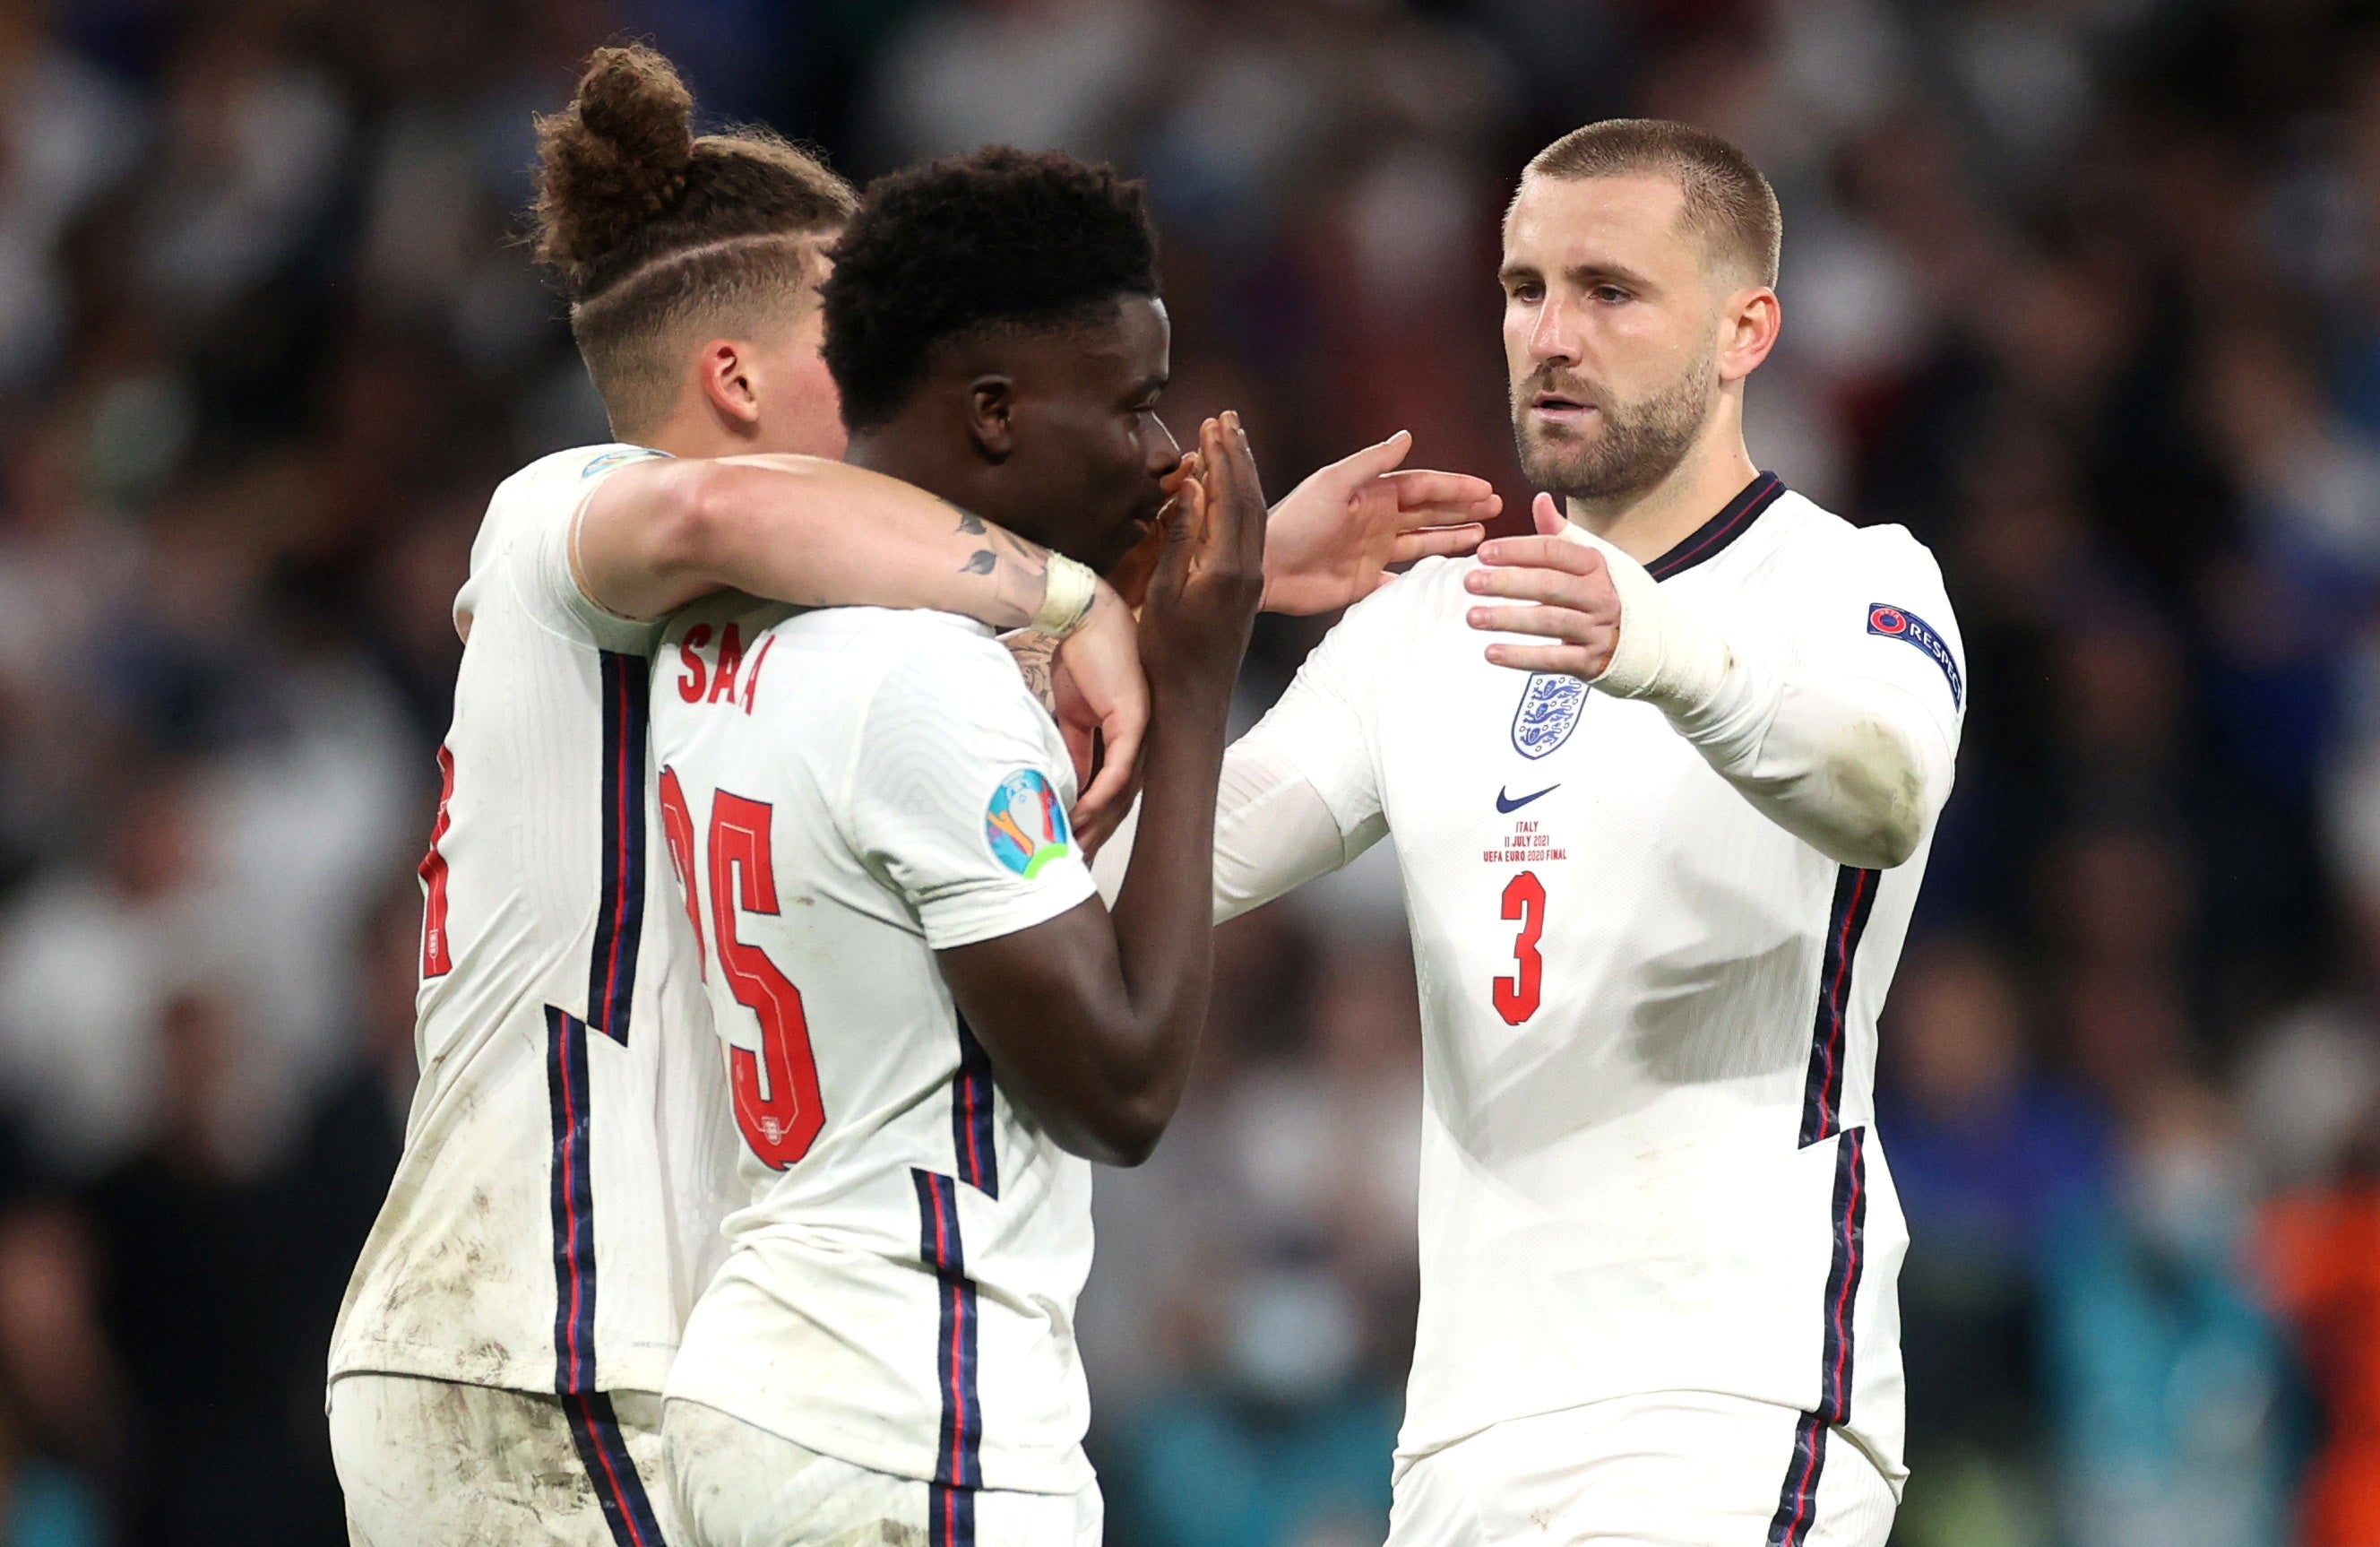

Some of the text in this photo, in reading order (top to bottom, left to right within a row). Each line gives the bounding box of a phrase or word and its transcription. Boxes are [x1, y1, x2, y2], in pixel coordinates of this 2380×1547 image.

[1516, 821, 1539, 833] ITALY
[1512, 835, 1531, 847] JULY
[1533, 835, 1549, 846] 2021
[1483, 849, 1567, 862] UEFA EURO 2020 FINAL
[1493, 870, 1546, 1025] 3
